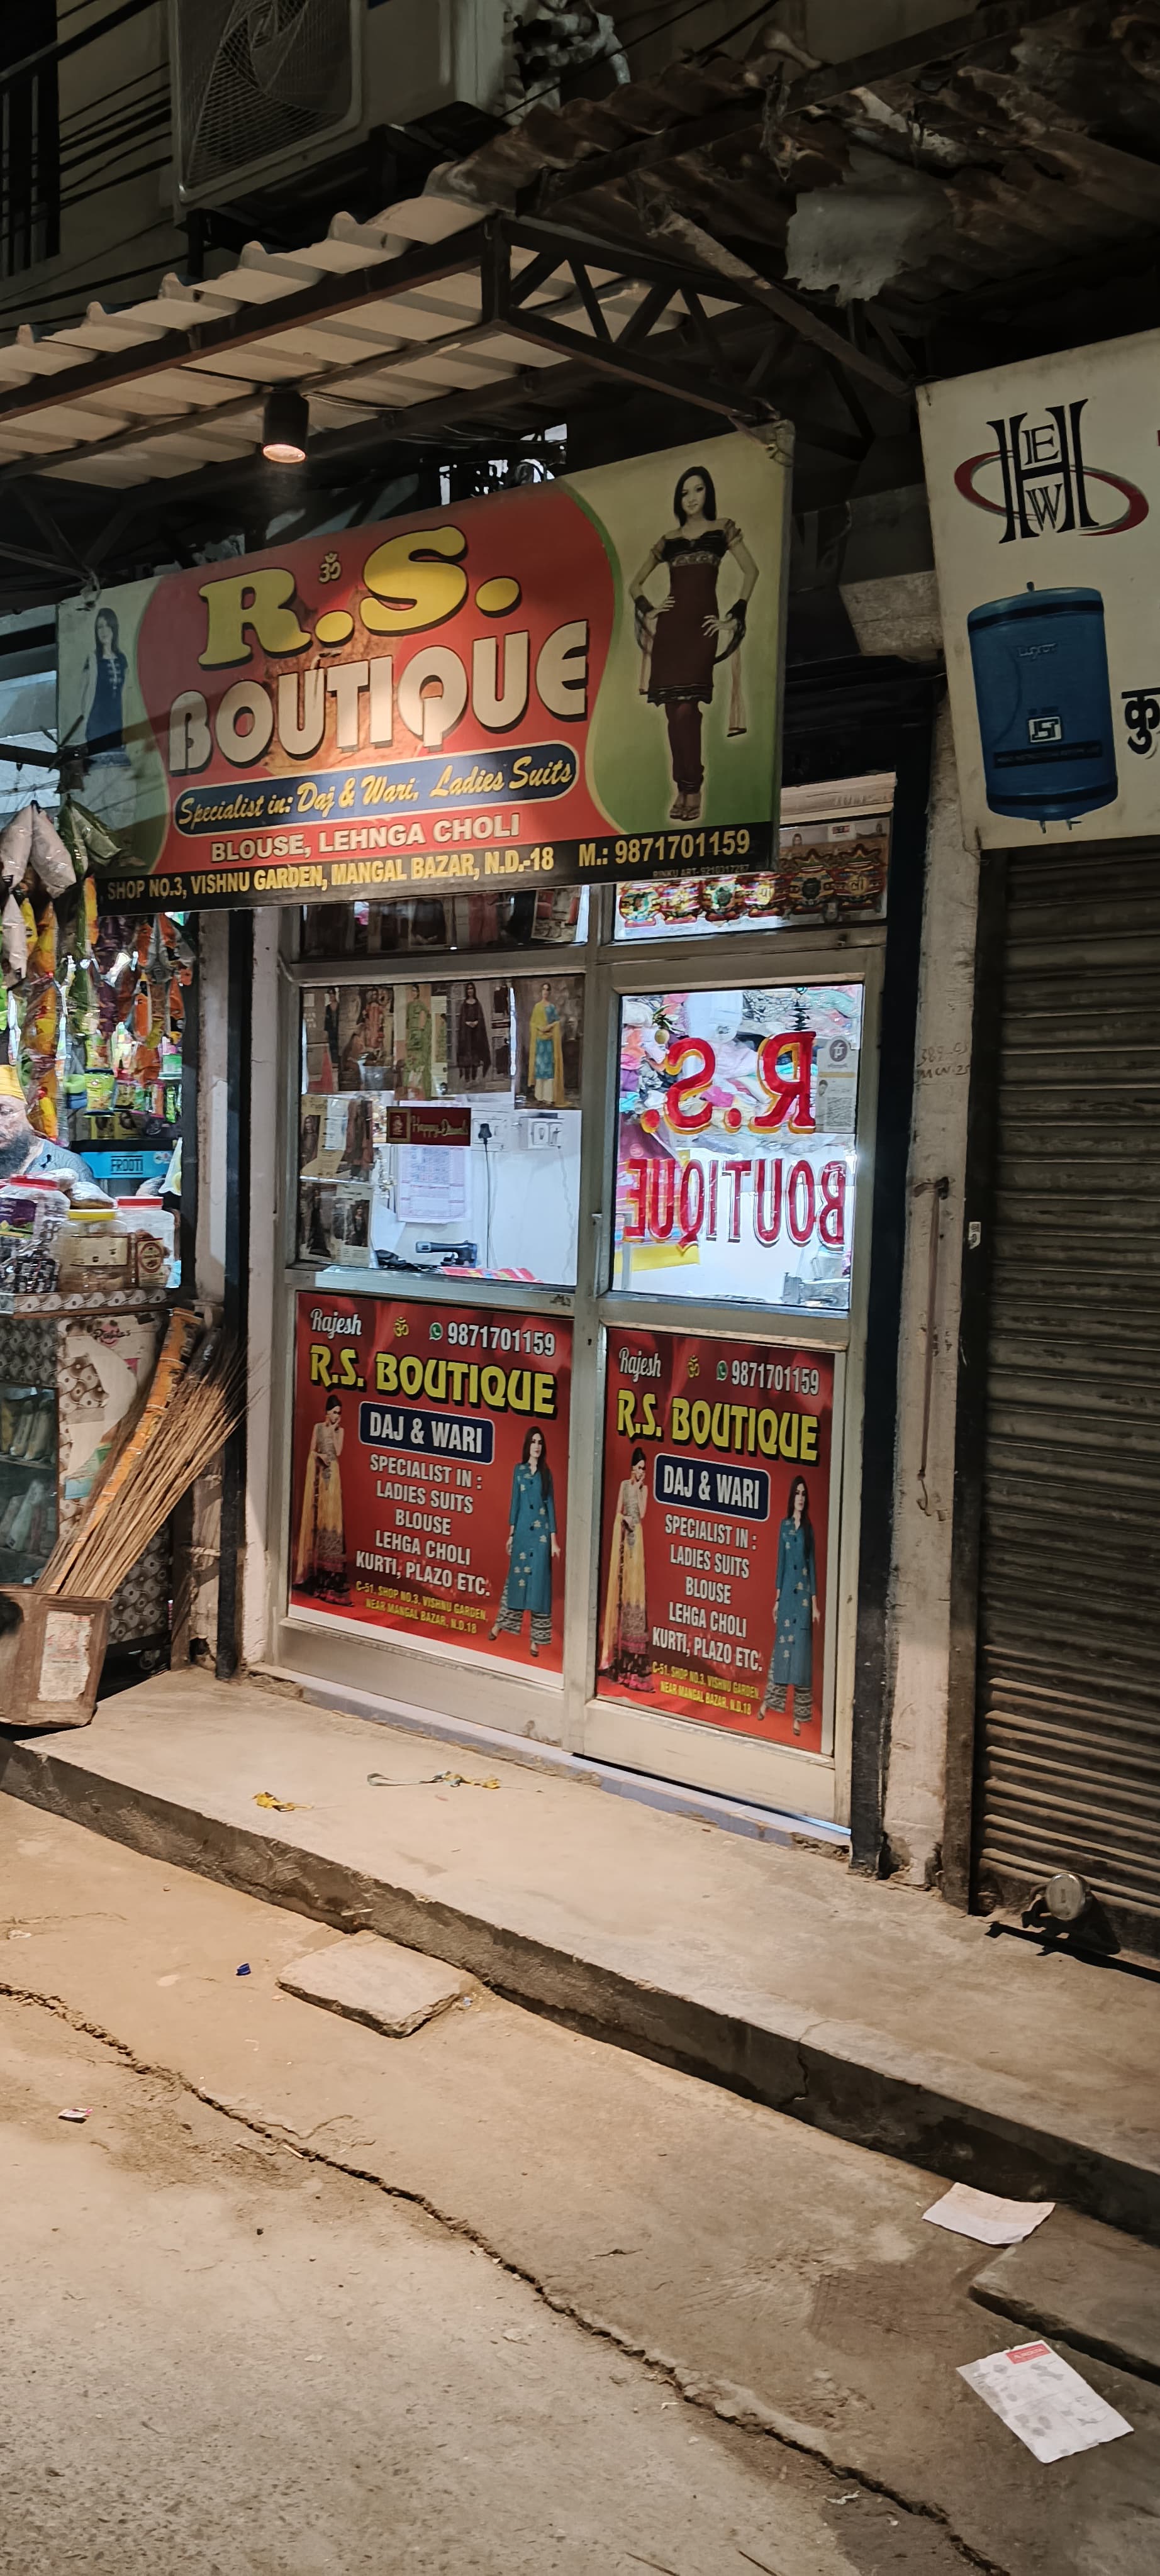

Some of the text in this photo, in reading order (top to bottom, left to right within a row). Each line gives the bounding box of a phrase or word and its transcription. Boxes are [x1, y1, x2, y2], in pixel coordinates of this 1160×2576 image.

[198, 525, 521, 668] R.S.
[169, 619, 589, 774] BOUTIQUE
[179, 794, 264, 830] Specialist
[267, 794, 293, 815] in:
[296, 782, 336, 818] Daj
[338, 777, 356, 809] &
[430, 764, 505, 797] Ladies
[509, 755, 573, 790] Suits
[211, 813, 520, 863] BLOUSE, LEHNGA CHOLI
[108, 880, 146, 901] SHOP
[149, 877, 187, 899] NO.3,
[191, 871, 250, 895] VISHNU
[254, 865, 328, 891] GARDEN,
[331, 859, 408, 886] MANGAL
[410, 853, 480, 881] BAZAR,
[484, 847, 554, 875] N.D.-18
[615, 829, 750, 865] 9871701159
[310, 1308, 362, 1340] Rajesh
[447, 1322, 555, 1356] 9871701159
[310, 1344, 555, 1414] R.S. BOUTIQUE
[619, 1346, 661, 1383] Rajesh
[732, 1360, 820, 1396] 9871701159
[369, 1411, 482, 1453] DAJ & WARI
[616, 1389, 818, 1462] R.S. BOUTIQUE
[369, 1453, 453, 1484] SPECIALIST
[455, 1468, 472, 1488] IN
[663, 1464, 760, 1509] DAJ & WARI
[376, 1480, 474, 1514] LADIES SUITS
[395, 1508, 452, 1536] BLOUSE
[665, 1513, 733, 1546] SPECIALIST
[735, 1527, 749, 1549] IN
[376, 1530, 471, 1565] LEHGA CHOLI
[670, 1543, 750, 1579] LADIES SUITS
[355, 1550, 491, 1597] KURTI, PLAZO ETC.
[685, 1575, 732, 1604] BLOUSE
[365, 1598, 386, 1612] NEAR
[387, 1602, 419, 1619] MANGAL
[378, 1585, 399, 1599] SHOP
[422, 1596, 452, 1612] VISHNU
[669, 1601, 747, 1638] LEHGA CHOLI
[652, 1626, 763, 1672] KURTI, PLAZO ETC.
[660, 1680, 678, 1696] NEAR
[678, 1685, 705, 1703] MANGAL
[671, 1666, 689, 1680] SHOP
[707, 1675, 732, 1692] VISHNU
